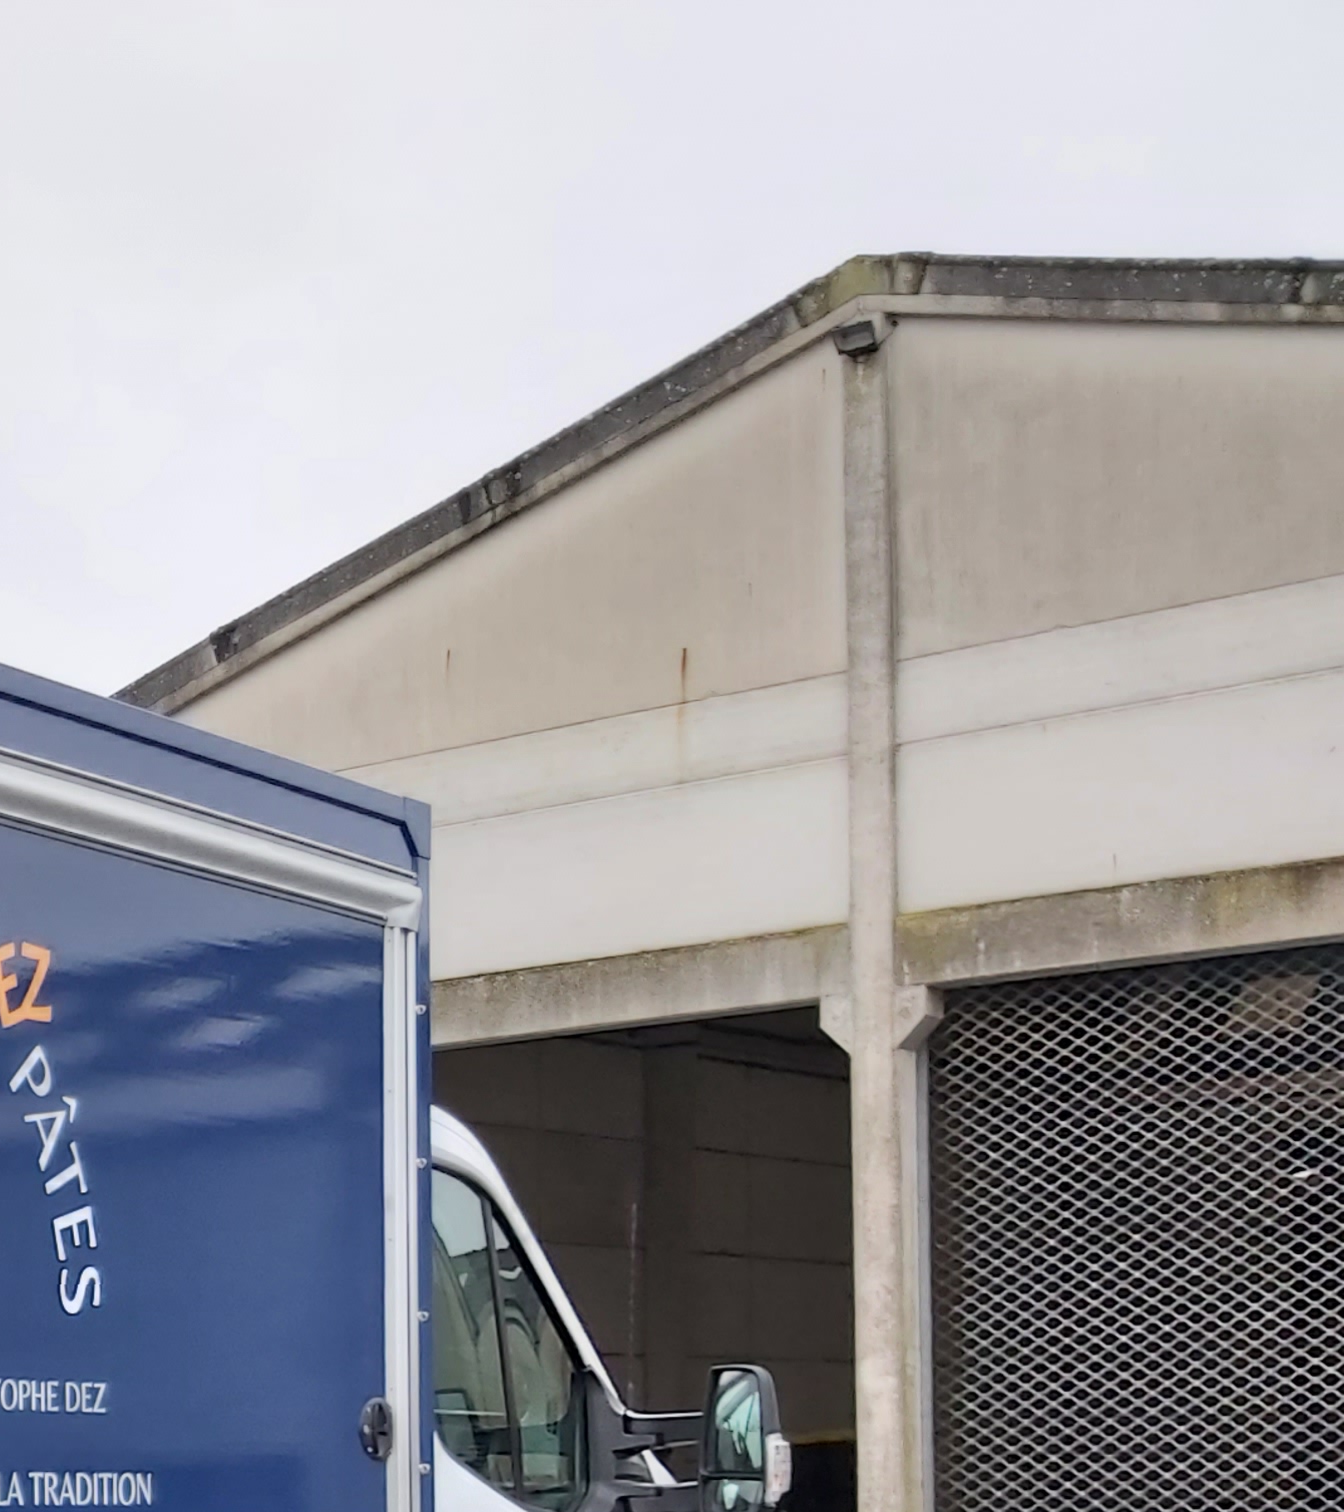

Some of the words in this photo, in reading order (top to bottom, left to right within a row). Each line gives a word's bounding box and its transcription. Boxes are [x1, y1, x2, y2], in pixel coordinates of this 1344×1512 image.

[10, 1045, 101, 1316] PÂTES
[65, 1381, 107, 1413] DEZ
[28, 1472, 152, 1507] TRADITION
